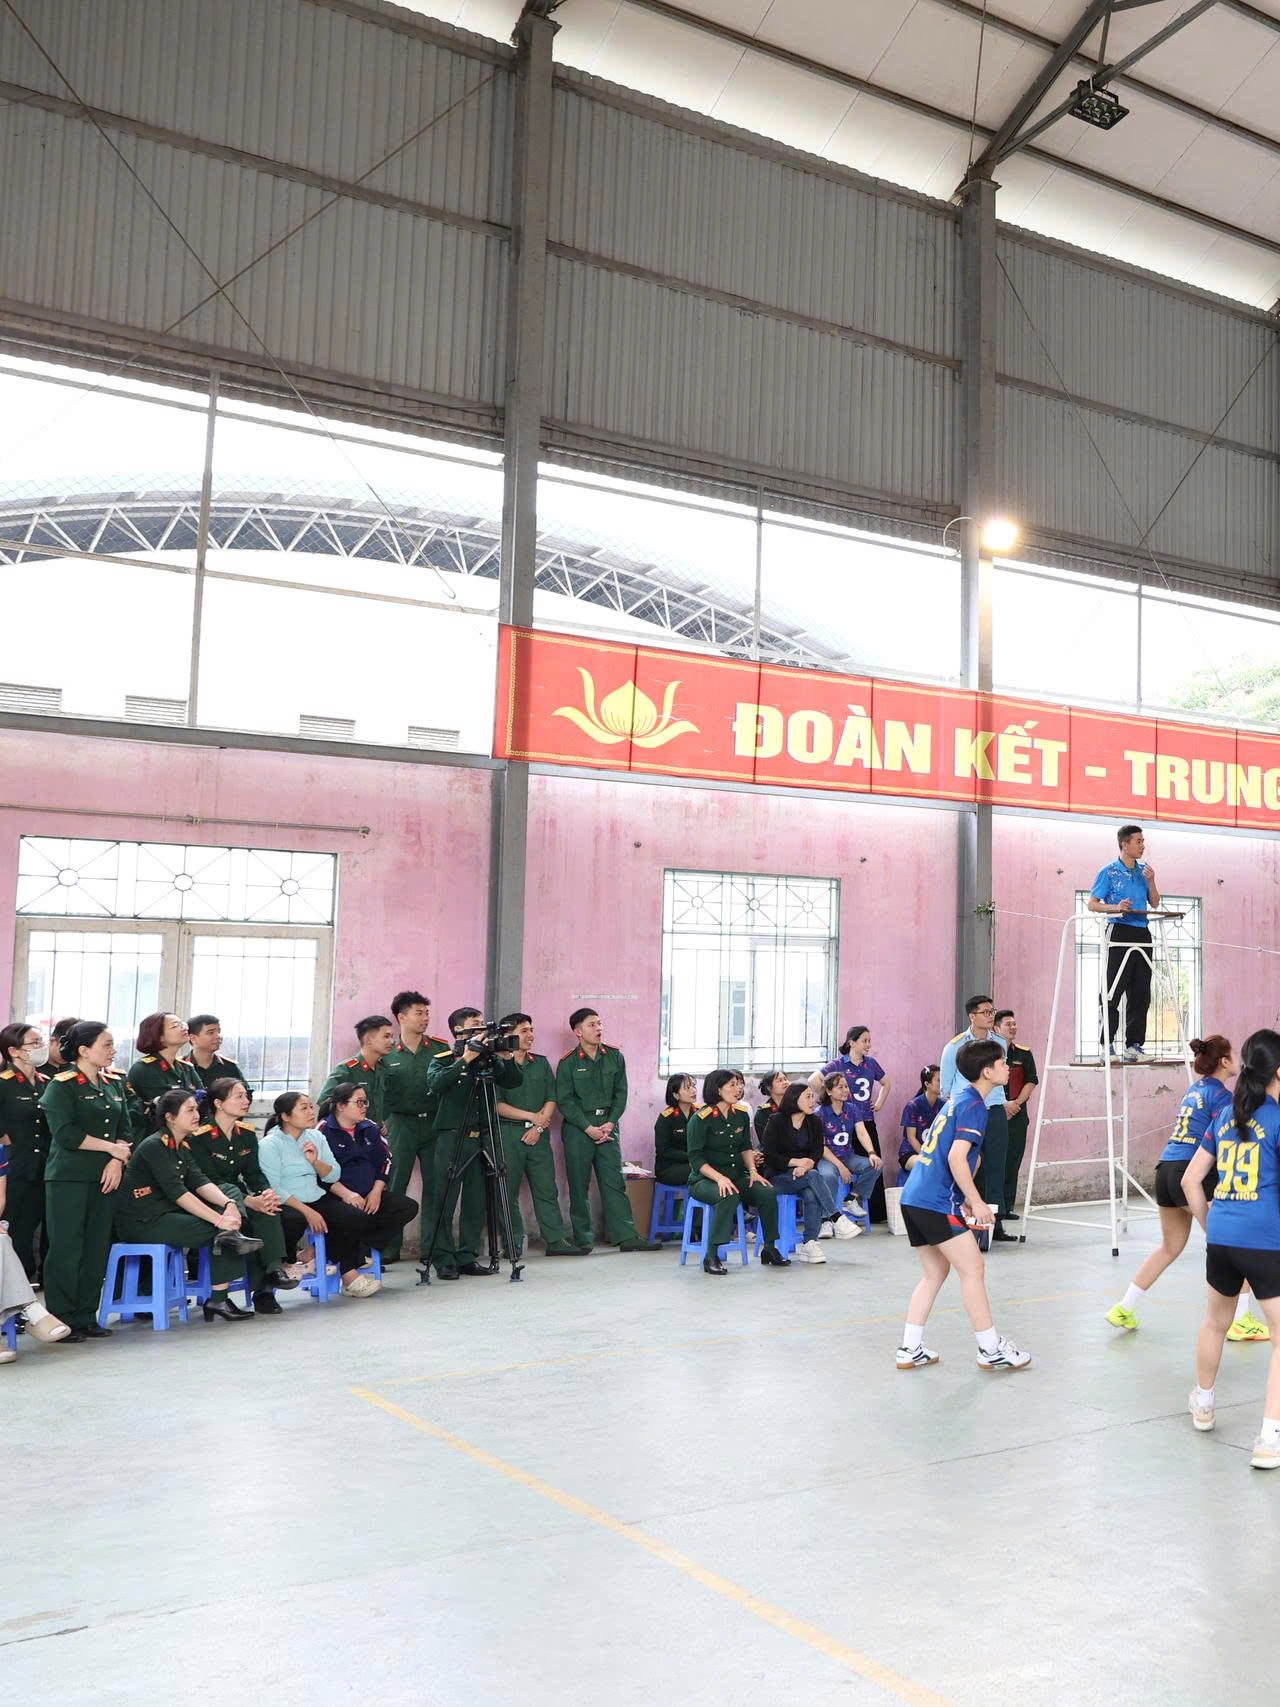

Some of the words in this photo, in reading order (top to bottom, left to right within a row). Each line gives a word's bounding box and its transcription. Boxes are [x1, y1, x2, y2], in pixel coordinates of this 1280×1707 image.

[732, 702, 931, 774] ĐOÀN
[954, 720, 1068, 787] KẾT
[853, 1077, 871, 1102] 3
[1214, 1140, 1260, 1193] 99
